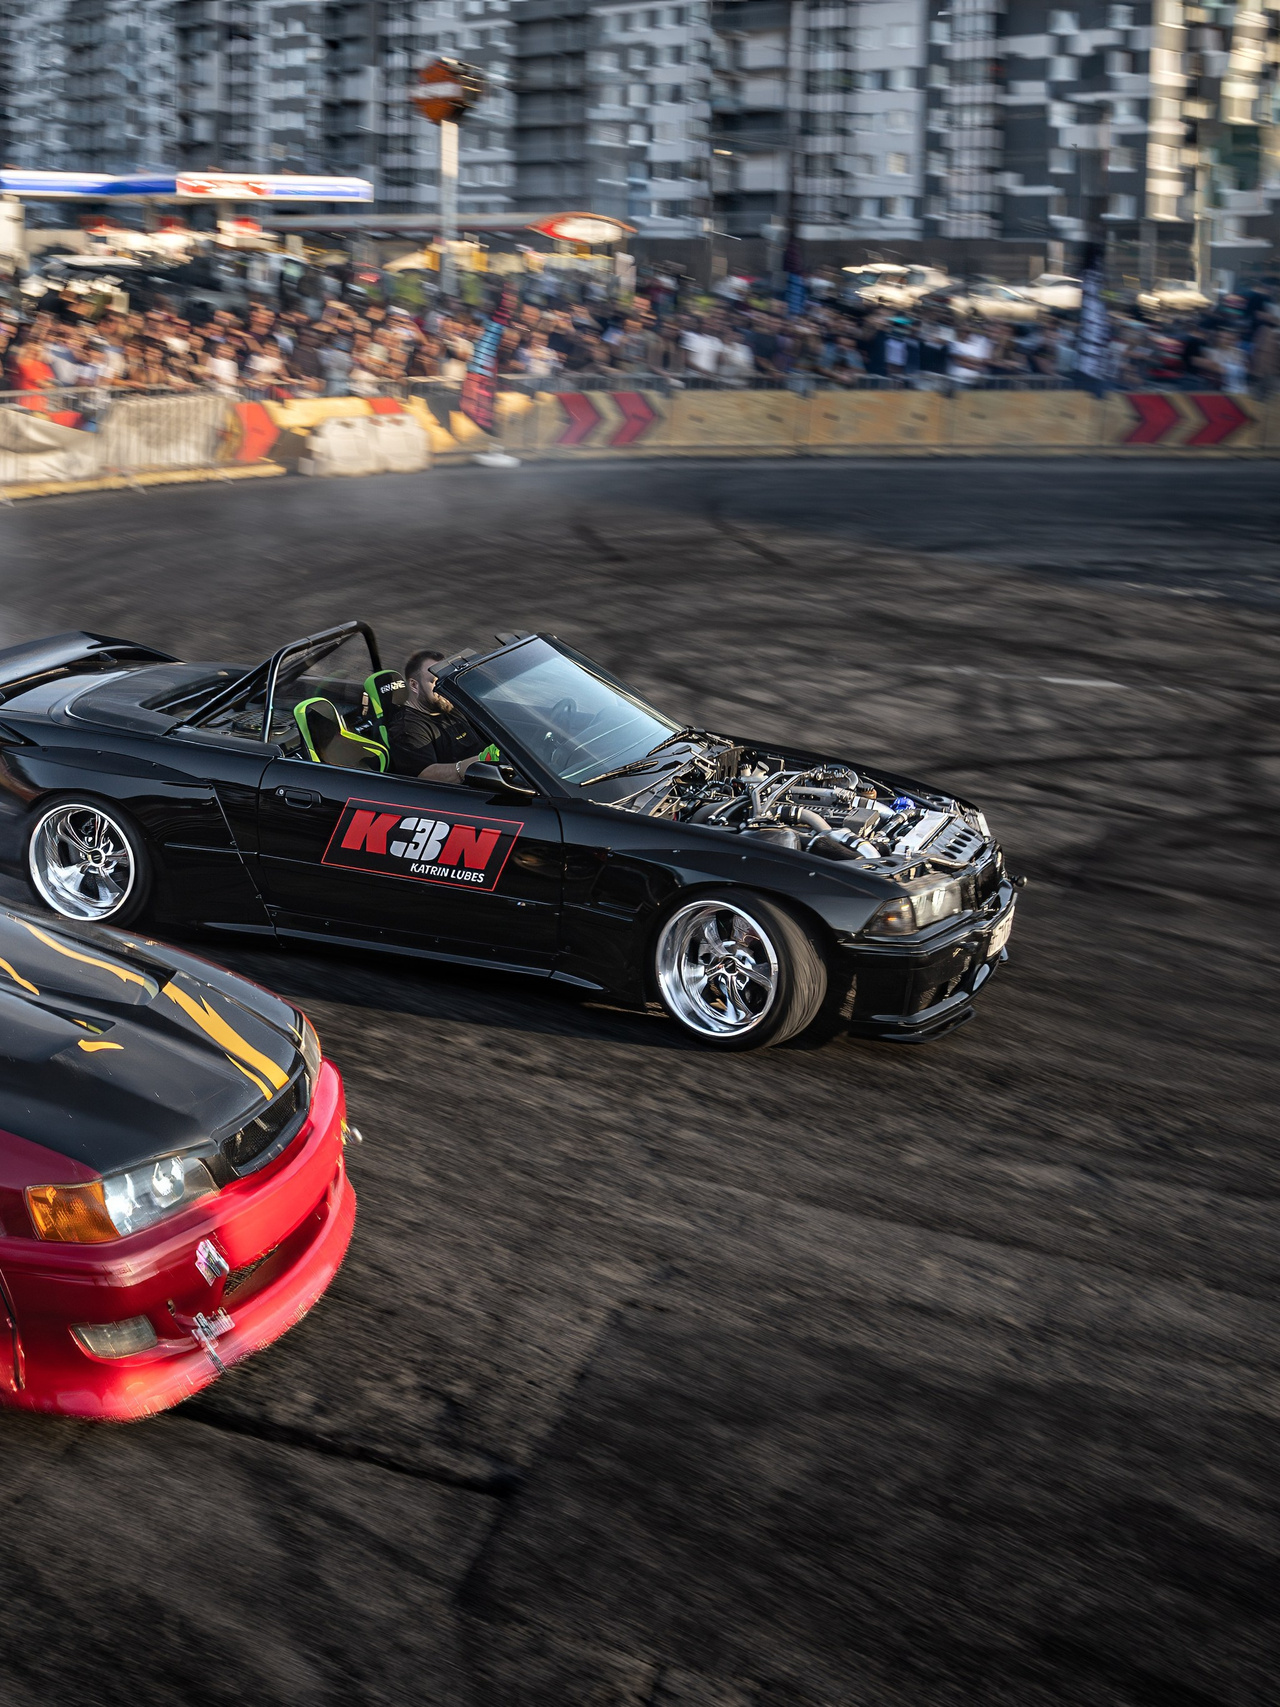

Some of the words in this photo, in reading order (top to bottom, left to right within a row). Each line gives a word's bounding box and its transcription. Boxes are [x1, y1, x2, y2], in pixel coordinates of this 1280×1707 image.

[340, 808, 502, 870] K3N
[410, 862, 449, 878] KATRIN
[450, 866, 486, 883] LUBES
